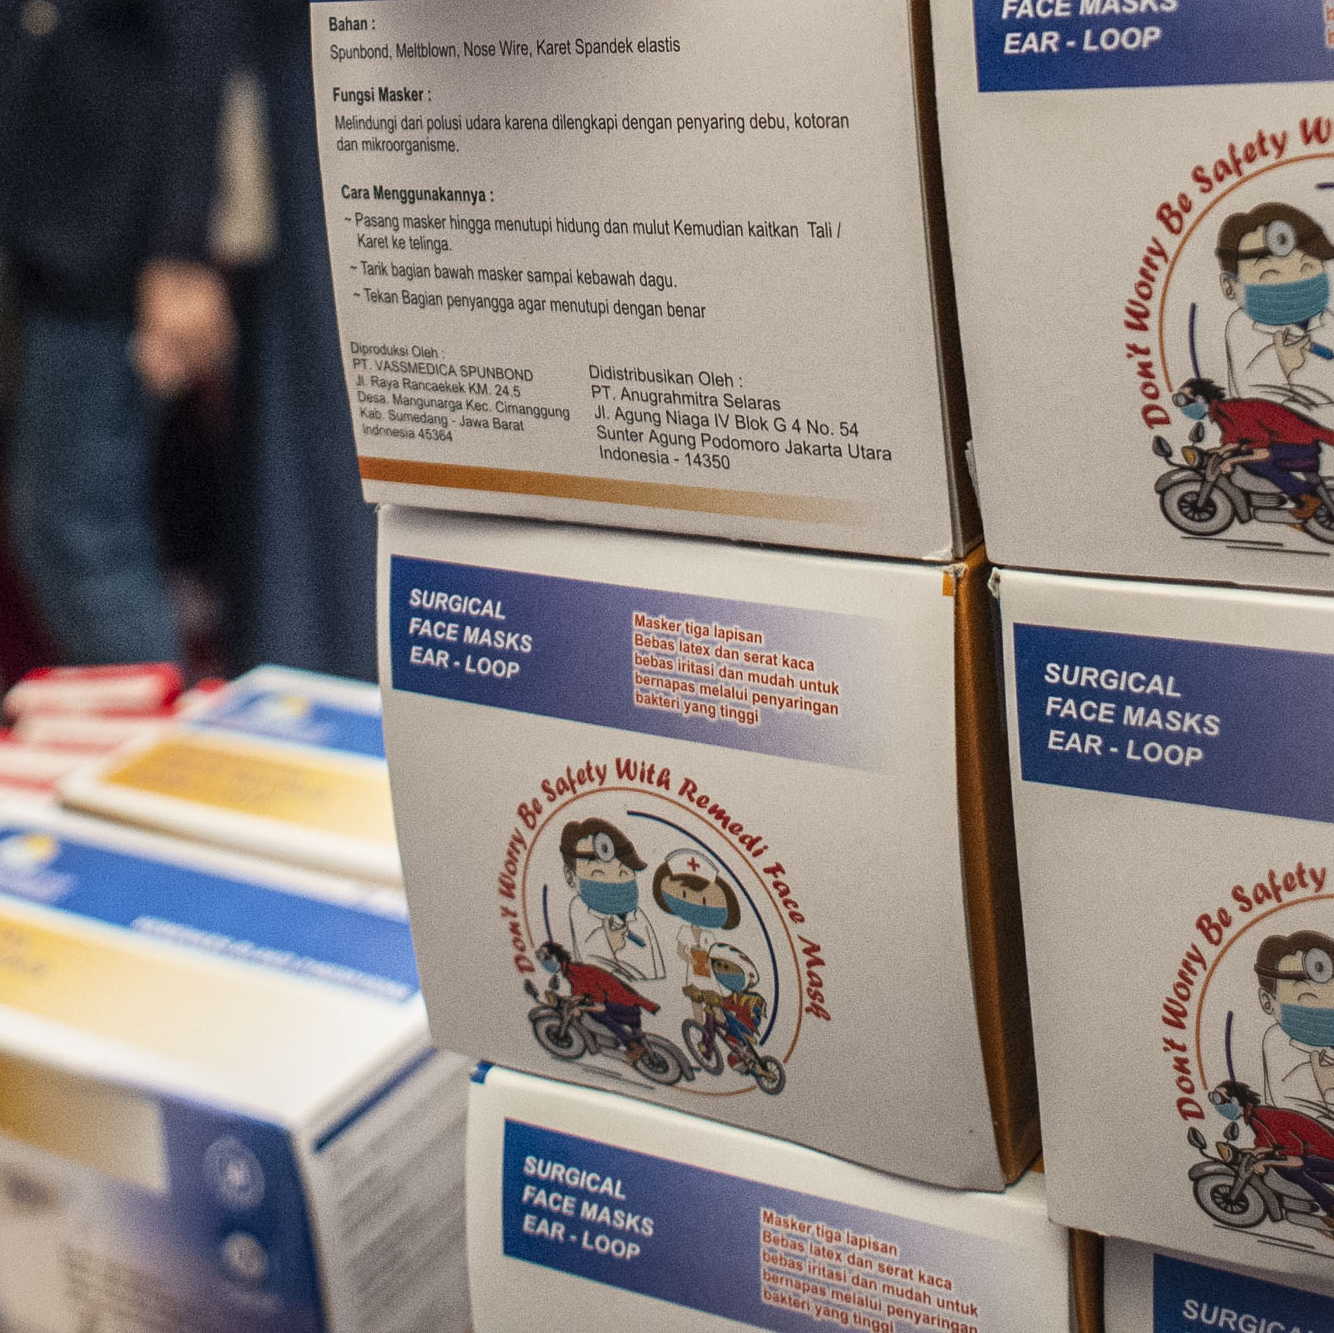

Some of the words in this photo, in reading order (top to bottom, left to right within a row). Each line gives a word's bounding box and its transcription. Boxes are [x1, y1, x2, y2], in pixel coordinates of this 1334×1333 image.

[328, 15, 369, 33] Bahan
[1003, 30, 1061, 55] EAR
[1082, 25, 1163, 52] LOOP
[329, 43, 393, 64] Spunbond,
[395, 41, 461, 60] Meltblown,
[462, 40, 497, 58] Nose
[498, 39, 534, 59] Wire,
[535, 38, 573, 56] Karet
[574, 37, 635, 59] Spandek
[636, 36, 682, 54] elastis
[331, 86, 376, 107] Fungsi
[377, 85, 425, 103] Masker
[1191, 129, 1289, 195] Safety
[340, 183, 371, 201] Cara
[372, 184, 487, 207] Menggunakannya
[1156, 192, 1194, 236] Be
[1124, 236, 1169, 333] Worry
[587, 363, 695, 386] Didistribusikan
[697, 370, 735, 388] Oleh
[1126, 342, 1172, 430] Don't
[590, 383, 616, 401] PT.
[619, 385, 720, 408] Anugrahmitra
[722, 392, 782, 412] Selaras
[593, 404, 610, 421] Jl.
[613, 405, 663, 429] Agung
[664, 409, 711, 431] Niaga
[713, 412, 731, 429] IV
[733, 413, 770, 433] Blok
[772, 416, 788, 434] G
[790, 417, 802, 435] 4
[805, 418, 835, 437] No.
[838, 420, 860, 438] 54
[595, 423, 645, 444] Sunter
[647, 428, 697, 452] Agung
[699, 431, 781, 454] Podomoro
[784, 438, 844, 459] Jakarta
[847, 442, 893, 462] Utara
[598, 444, 671, 466] Indonesia
[684, 451, 731, 471] 14350
[408, 587, 507, 621] SURGICAL
[408, 616, 460, 642] FACE
[462, 624, 533, 654] MASKS
[634, 613, 682, 633] Masker
[684, 621, 711, 640] tiga
[713, 624, 763, 644] lapisan
[409, 645, 450, 669] EAR
[464, 654, 521, 680] LOOP
[1043, 662, 1182, 698] SURGICAL
[1045, 695, 1117, 725] FACE
[1122, 704, 1221, 737] MASKS
[1047, 728, 1104, 756] EAR
[1125, 738, 1204, 768] LOOP
[523, 1155, 627, 1201] SURGICAL
[521, 1185, 577, 1217] FACE
[579, 1200, 655, 1238] MASKS
[522, 1213, 566, 1242] EAR
[581, 1229, 642, 1261] LOOP
